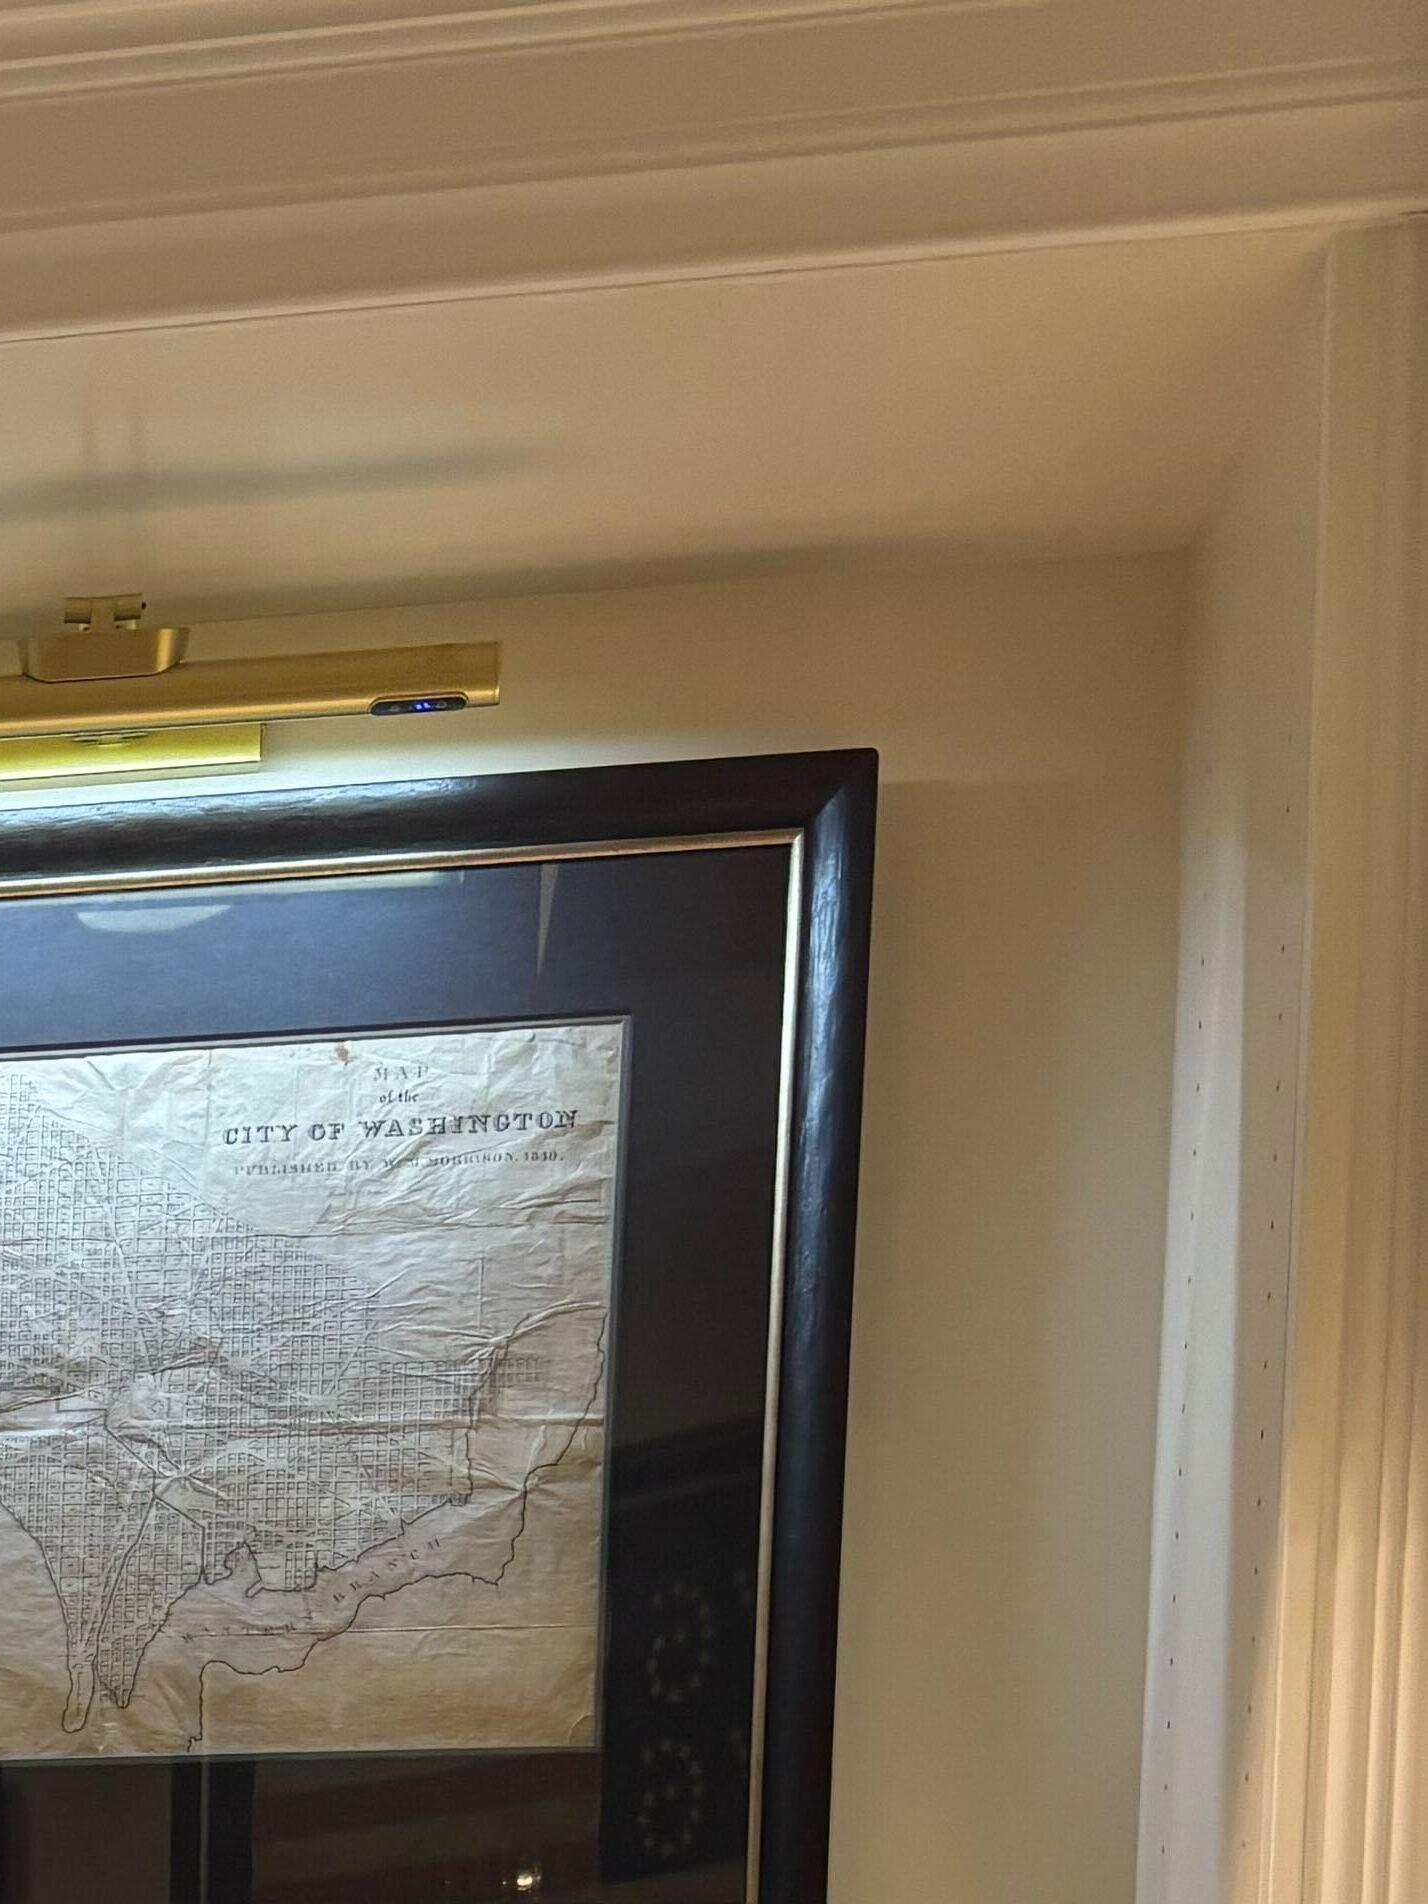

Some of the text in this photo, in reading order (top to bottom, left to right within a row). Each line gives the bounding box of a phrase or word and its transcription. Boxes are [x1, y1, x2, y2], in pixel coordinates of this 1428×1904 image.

[372, 1064, 431, 1082] MAP
[379, 1089, 420, 1105] of the
[223, 1108, 580, 1146] CITY OF WASHINGTON
